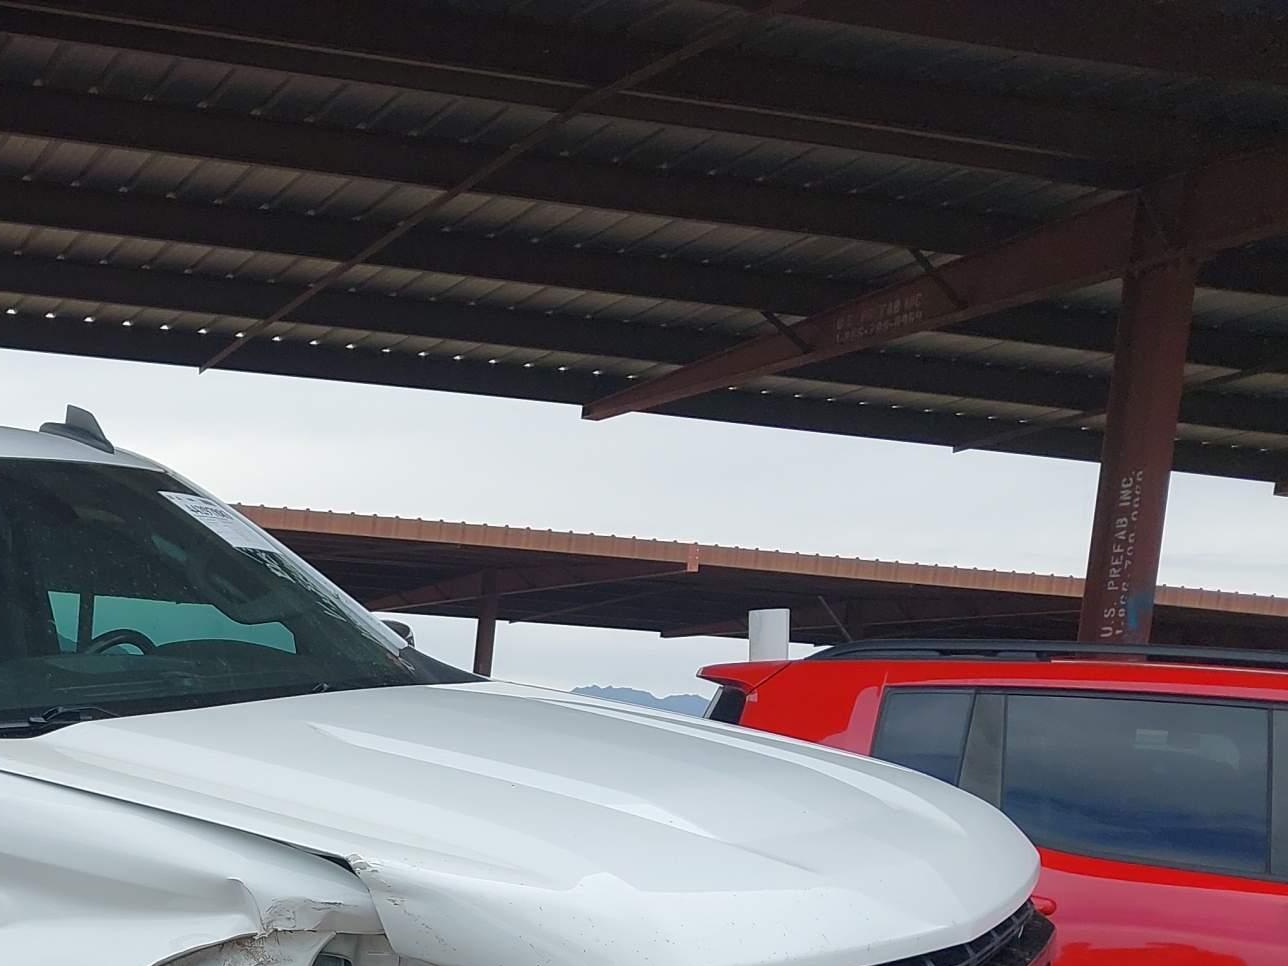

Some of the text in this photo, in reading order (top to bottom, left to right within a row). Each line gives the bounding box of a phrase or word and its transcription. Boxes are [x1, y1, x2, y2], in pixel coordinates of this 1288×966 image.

[1119, 471, 1135, 506] INC.
[1107, 517, 1129, 590] PREFAB
[1100, 602, 1117, 637] U.S.
